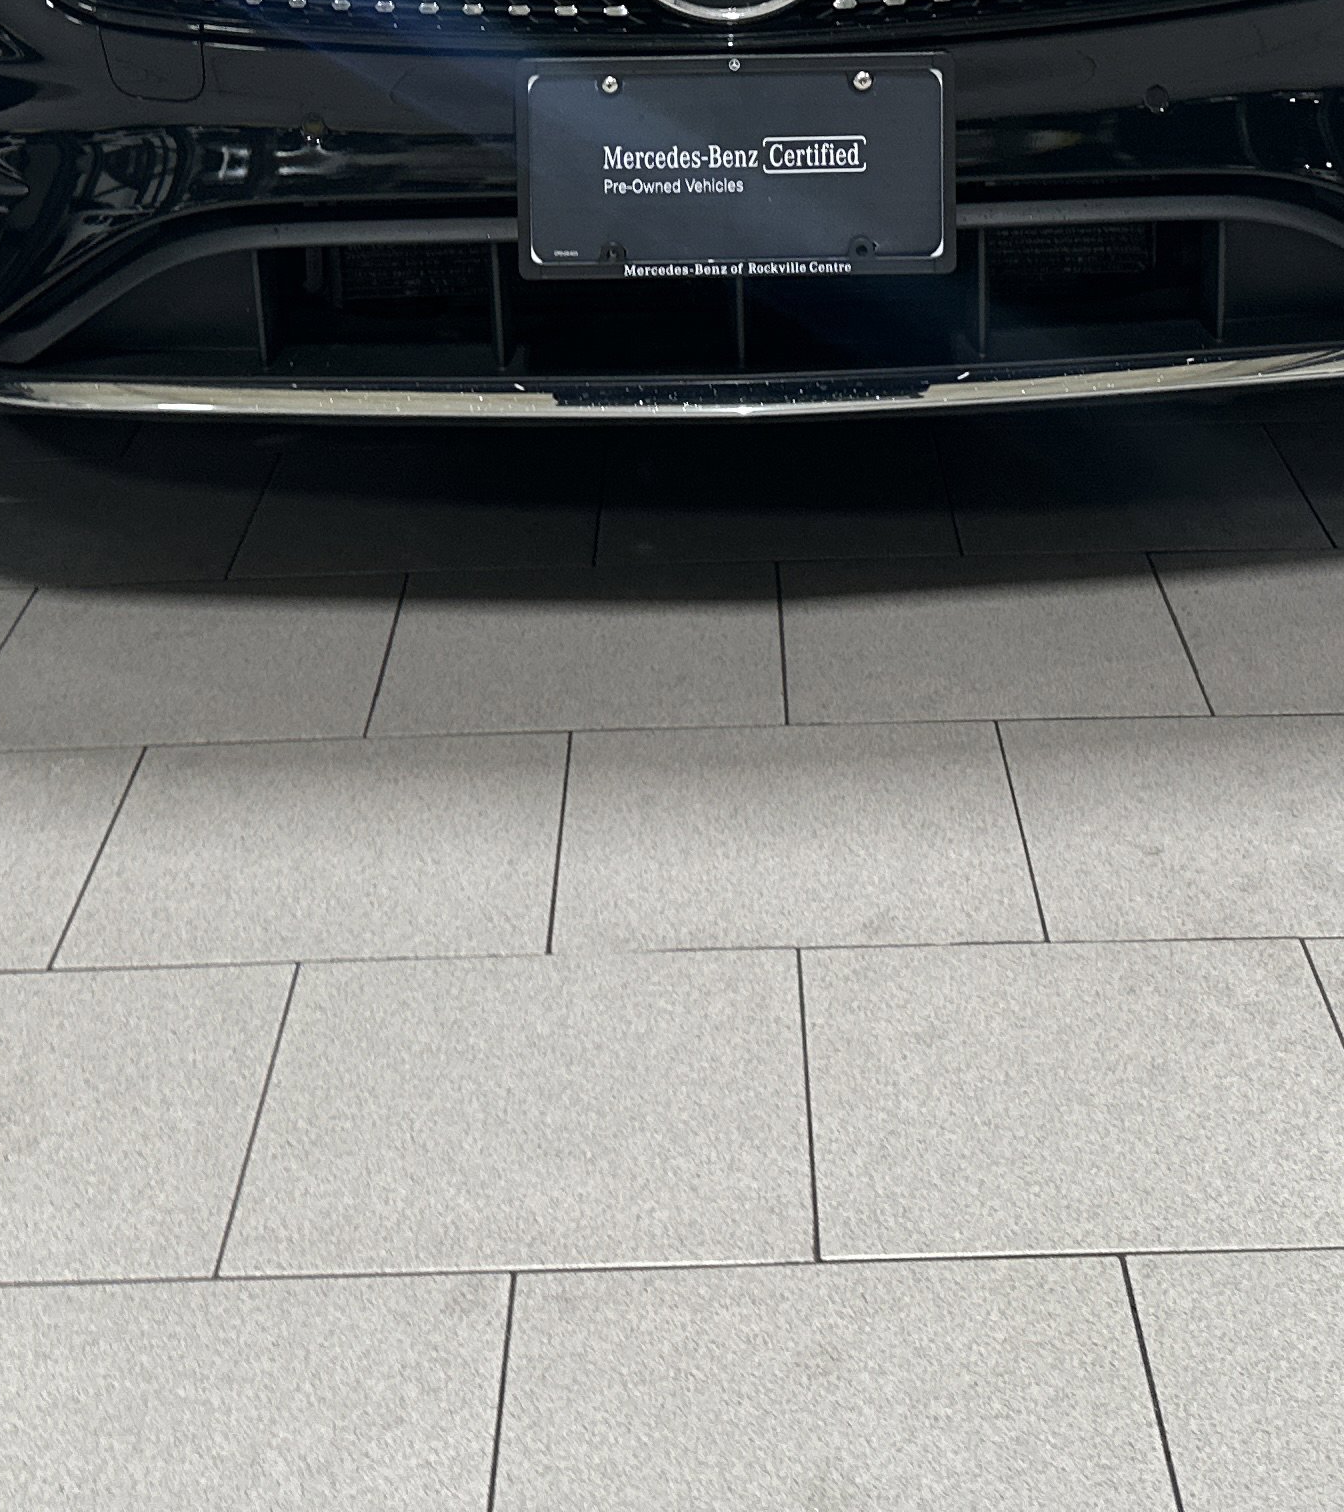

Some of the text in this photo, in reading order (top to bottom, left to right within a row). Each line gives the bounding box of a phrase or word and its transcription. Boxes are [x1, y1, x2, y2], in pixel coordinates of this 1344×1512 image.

[603, 142, 860, 170] Mercedes-Benz Certified
[603, 177, 744, 194] Pre-Owned Vehicles
[623, 261, 852, 277] Mercedes-Benz of Rockville Centre
